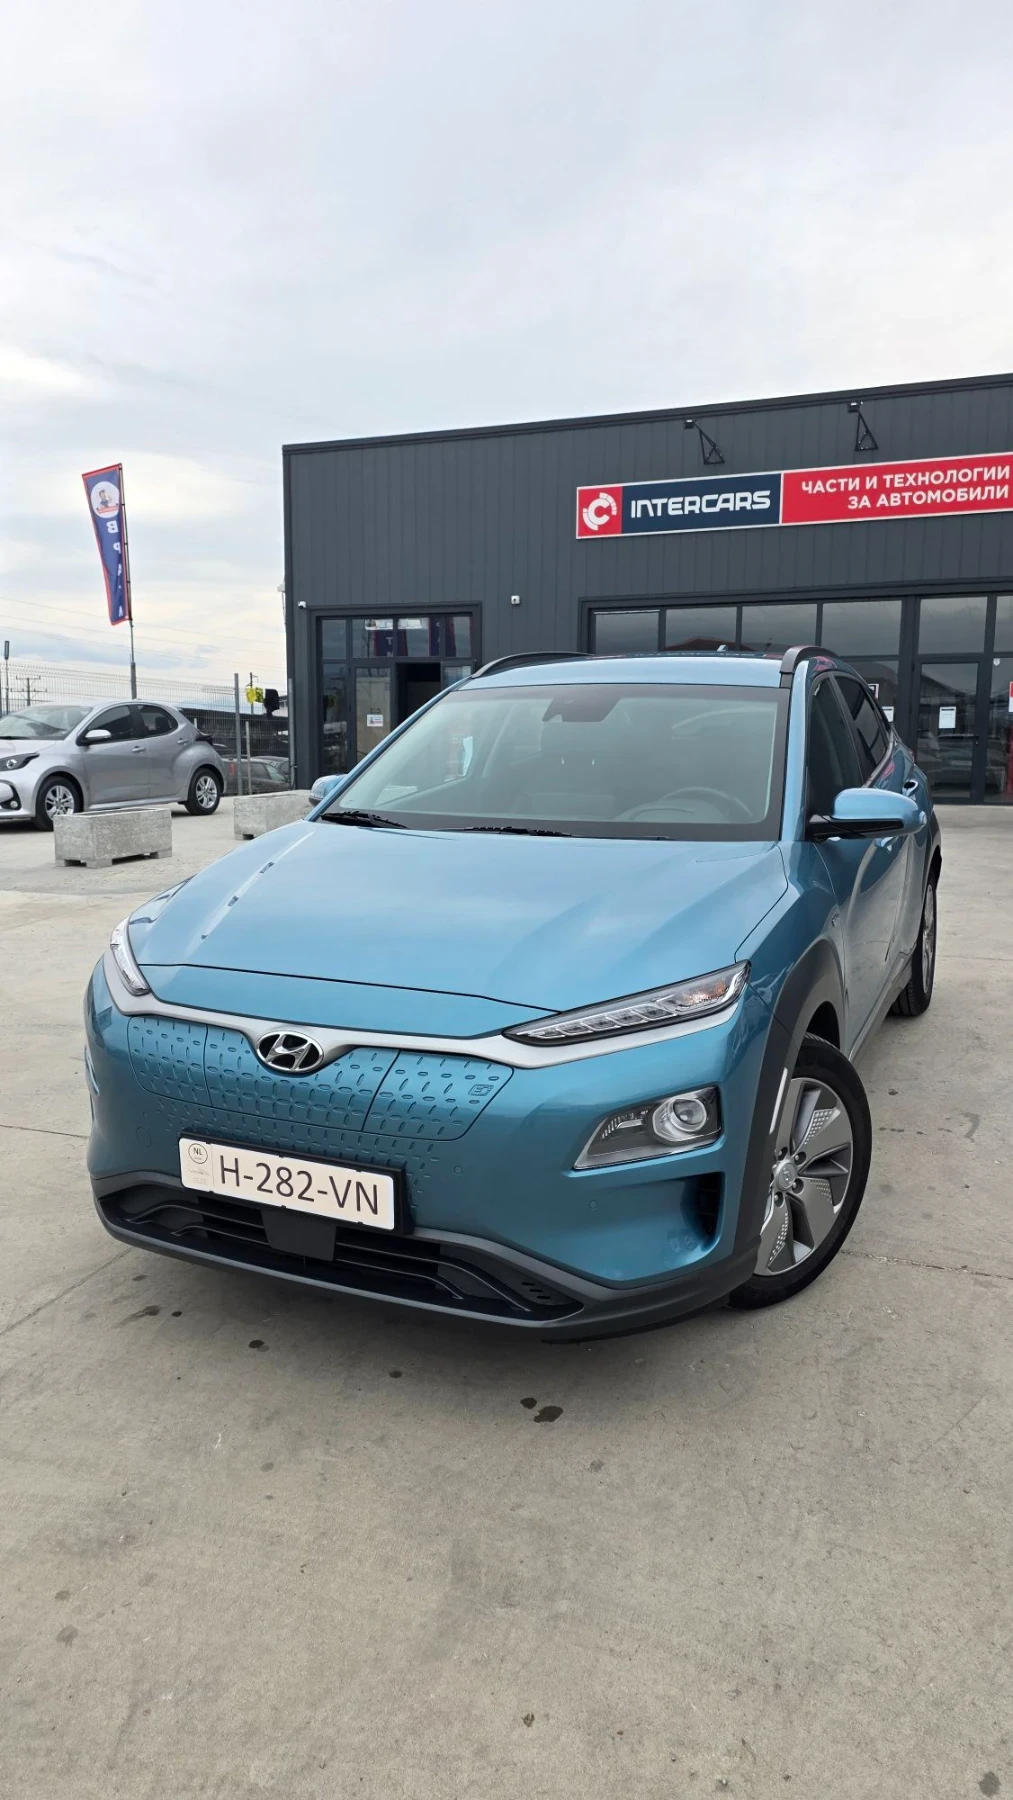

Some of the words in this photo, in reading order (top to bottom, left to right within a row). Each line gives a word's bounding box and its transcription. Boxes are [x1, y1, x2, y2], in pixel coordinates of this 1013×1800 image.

[802, 477, 860, 494] ЧАСТИ
[865, 476, 877, 489] И
[882, 465, 1010, 488] ТЕХНОЛОГИИ
[630, 489, 771, 519] INTERCARS
[847, 495, 872, 509] ЗА
[875, 484, 1009, 508] АВТОМОБИЛИ
[193, 1147, 203, 1156] NL
[219, 1155, 378, 1215] H-282-VN
